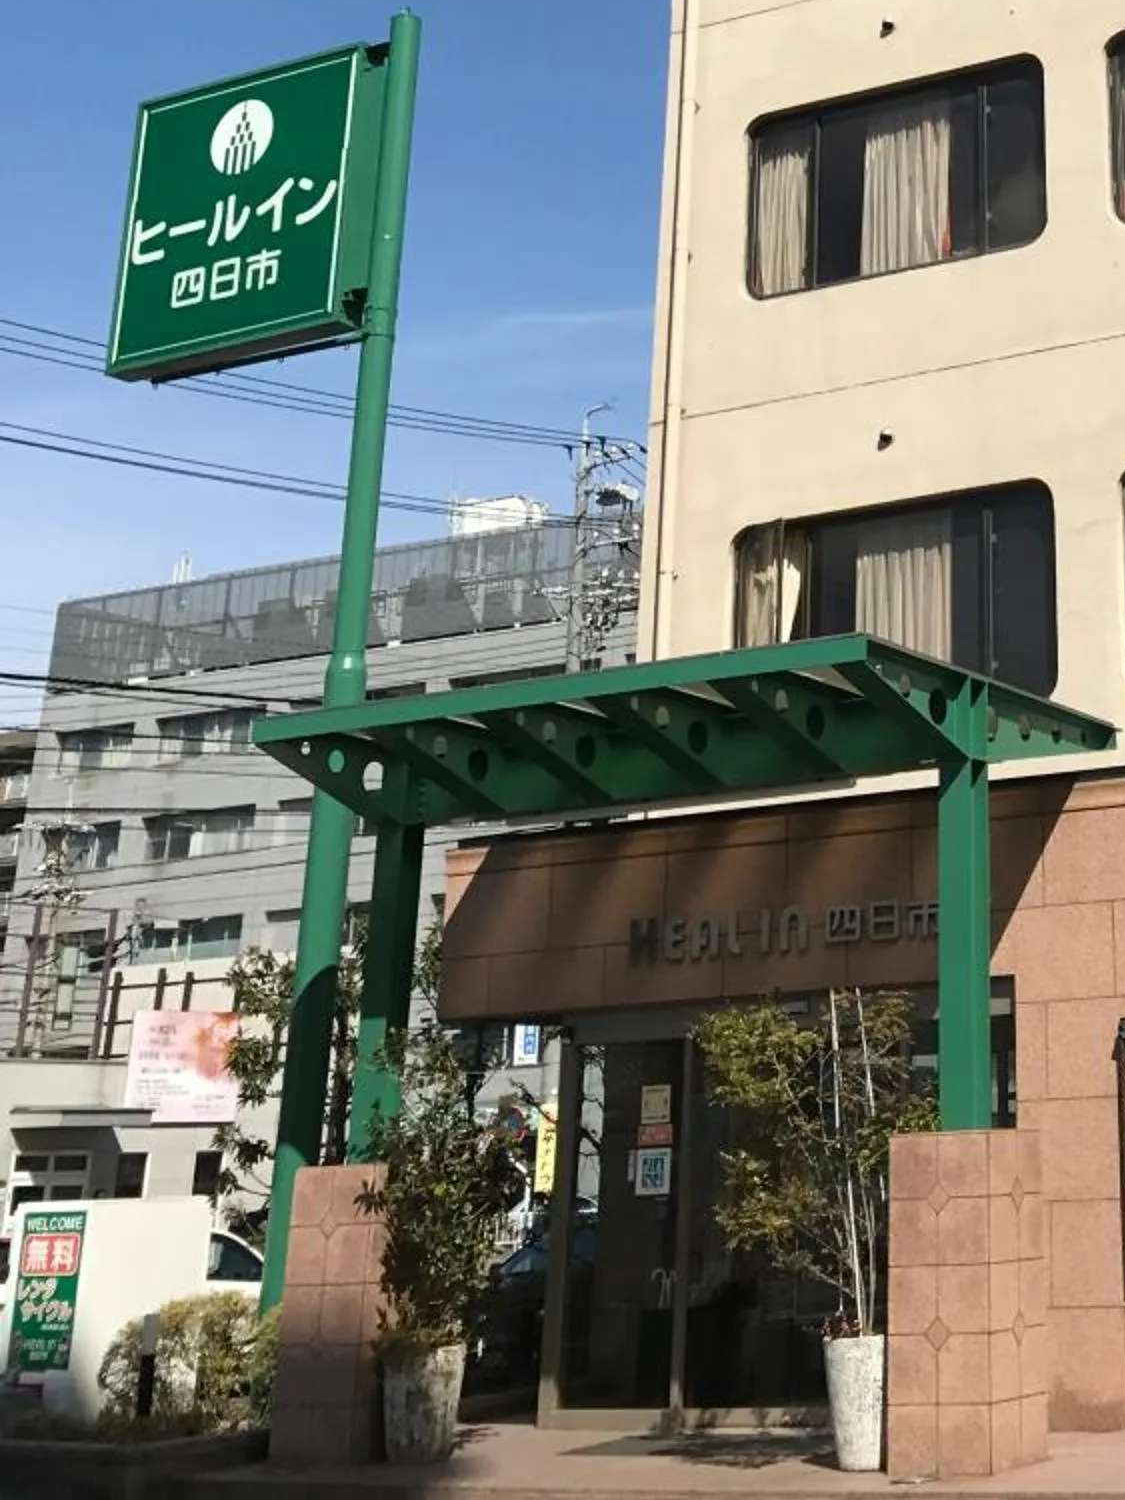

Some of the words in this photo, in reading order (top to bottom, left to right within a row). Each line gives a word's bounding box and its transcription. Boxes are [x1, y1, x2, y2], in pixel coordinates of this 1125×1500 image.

[131, 176, 338, 265] ヒールイン
[171, 249, 281, 308] 四日市
[825, 901, 939, 944] 四日市
[27, 1216, 84, 1231] WELCOME
